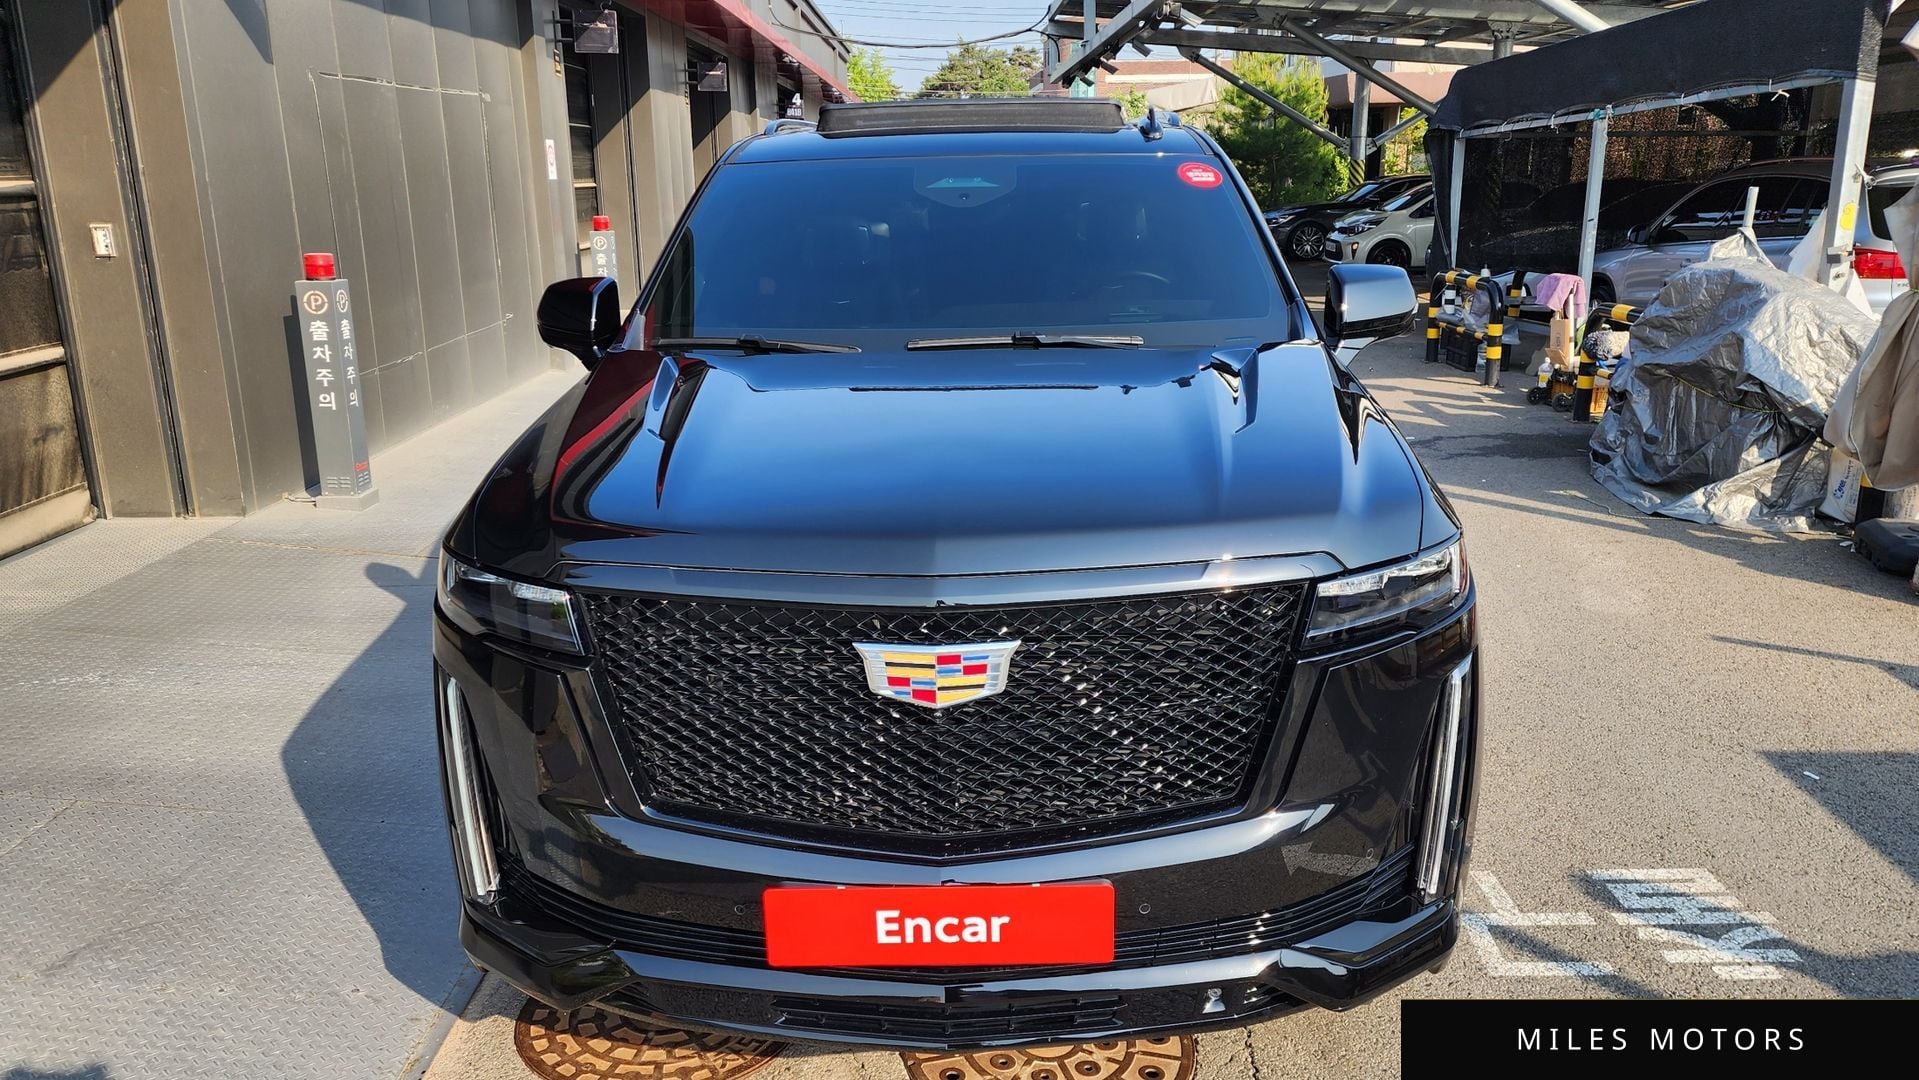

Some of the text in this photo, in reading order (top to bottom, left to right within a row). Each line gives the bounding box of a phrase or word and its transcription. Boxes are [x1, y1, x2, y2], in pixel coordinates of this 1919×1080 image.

[792, 93, 801, 105] 4
[310, 320, 336, 410] 출차주의
[341, 319, 359, 407] 출차주의
[876, 910, 1010, 943] Encar
